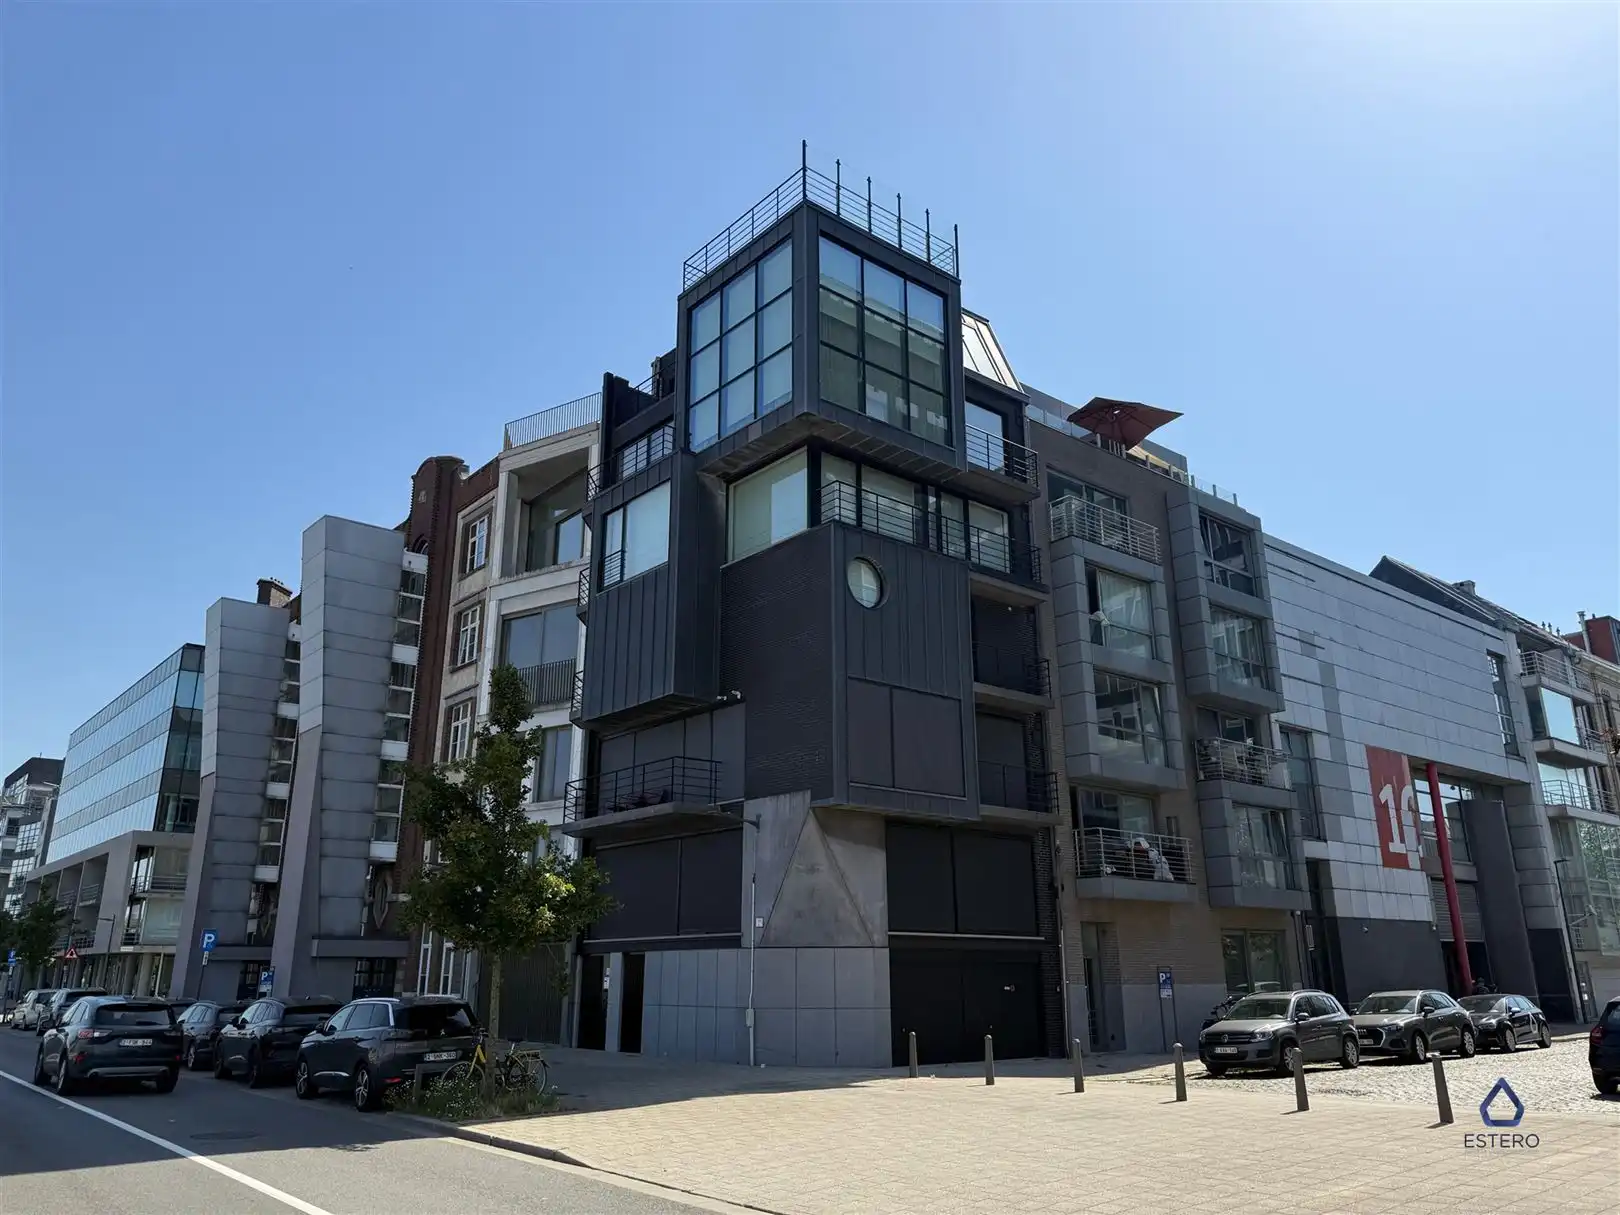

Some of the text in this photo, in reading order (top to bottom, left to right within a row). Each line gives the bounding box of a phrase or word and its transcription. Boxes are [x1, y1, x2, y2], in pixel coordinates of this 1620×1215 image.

[202, 933, 215, 949] P
[261, 971, 269, 981] P
[1159, 972, 1166, 983] P
